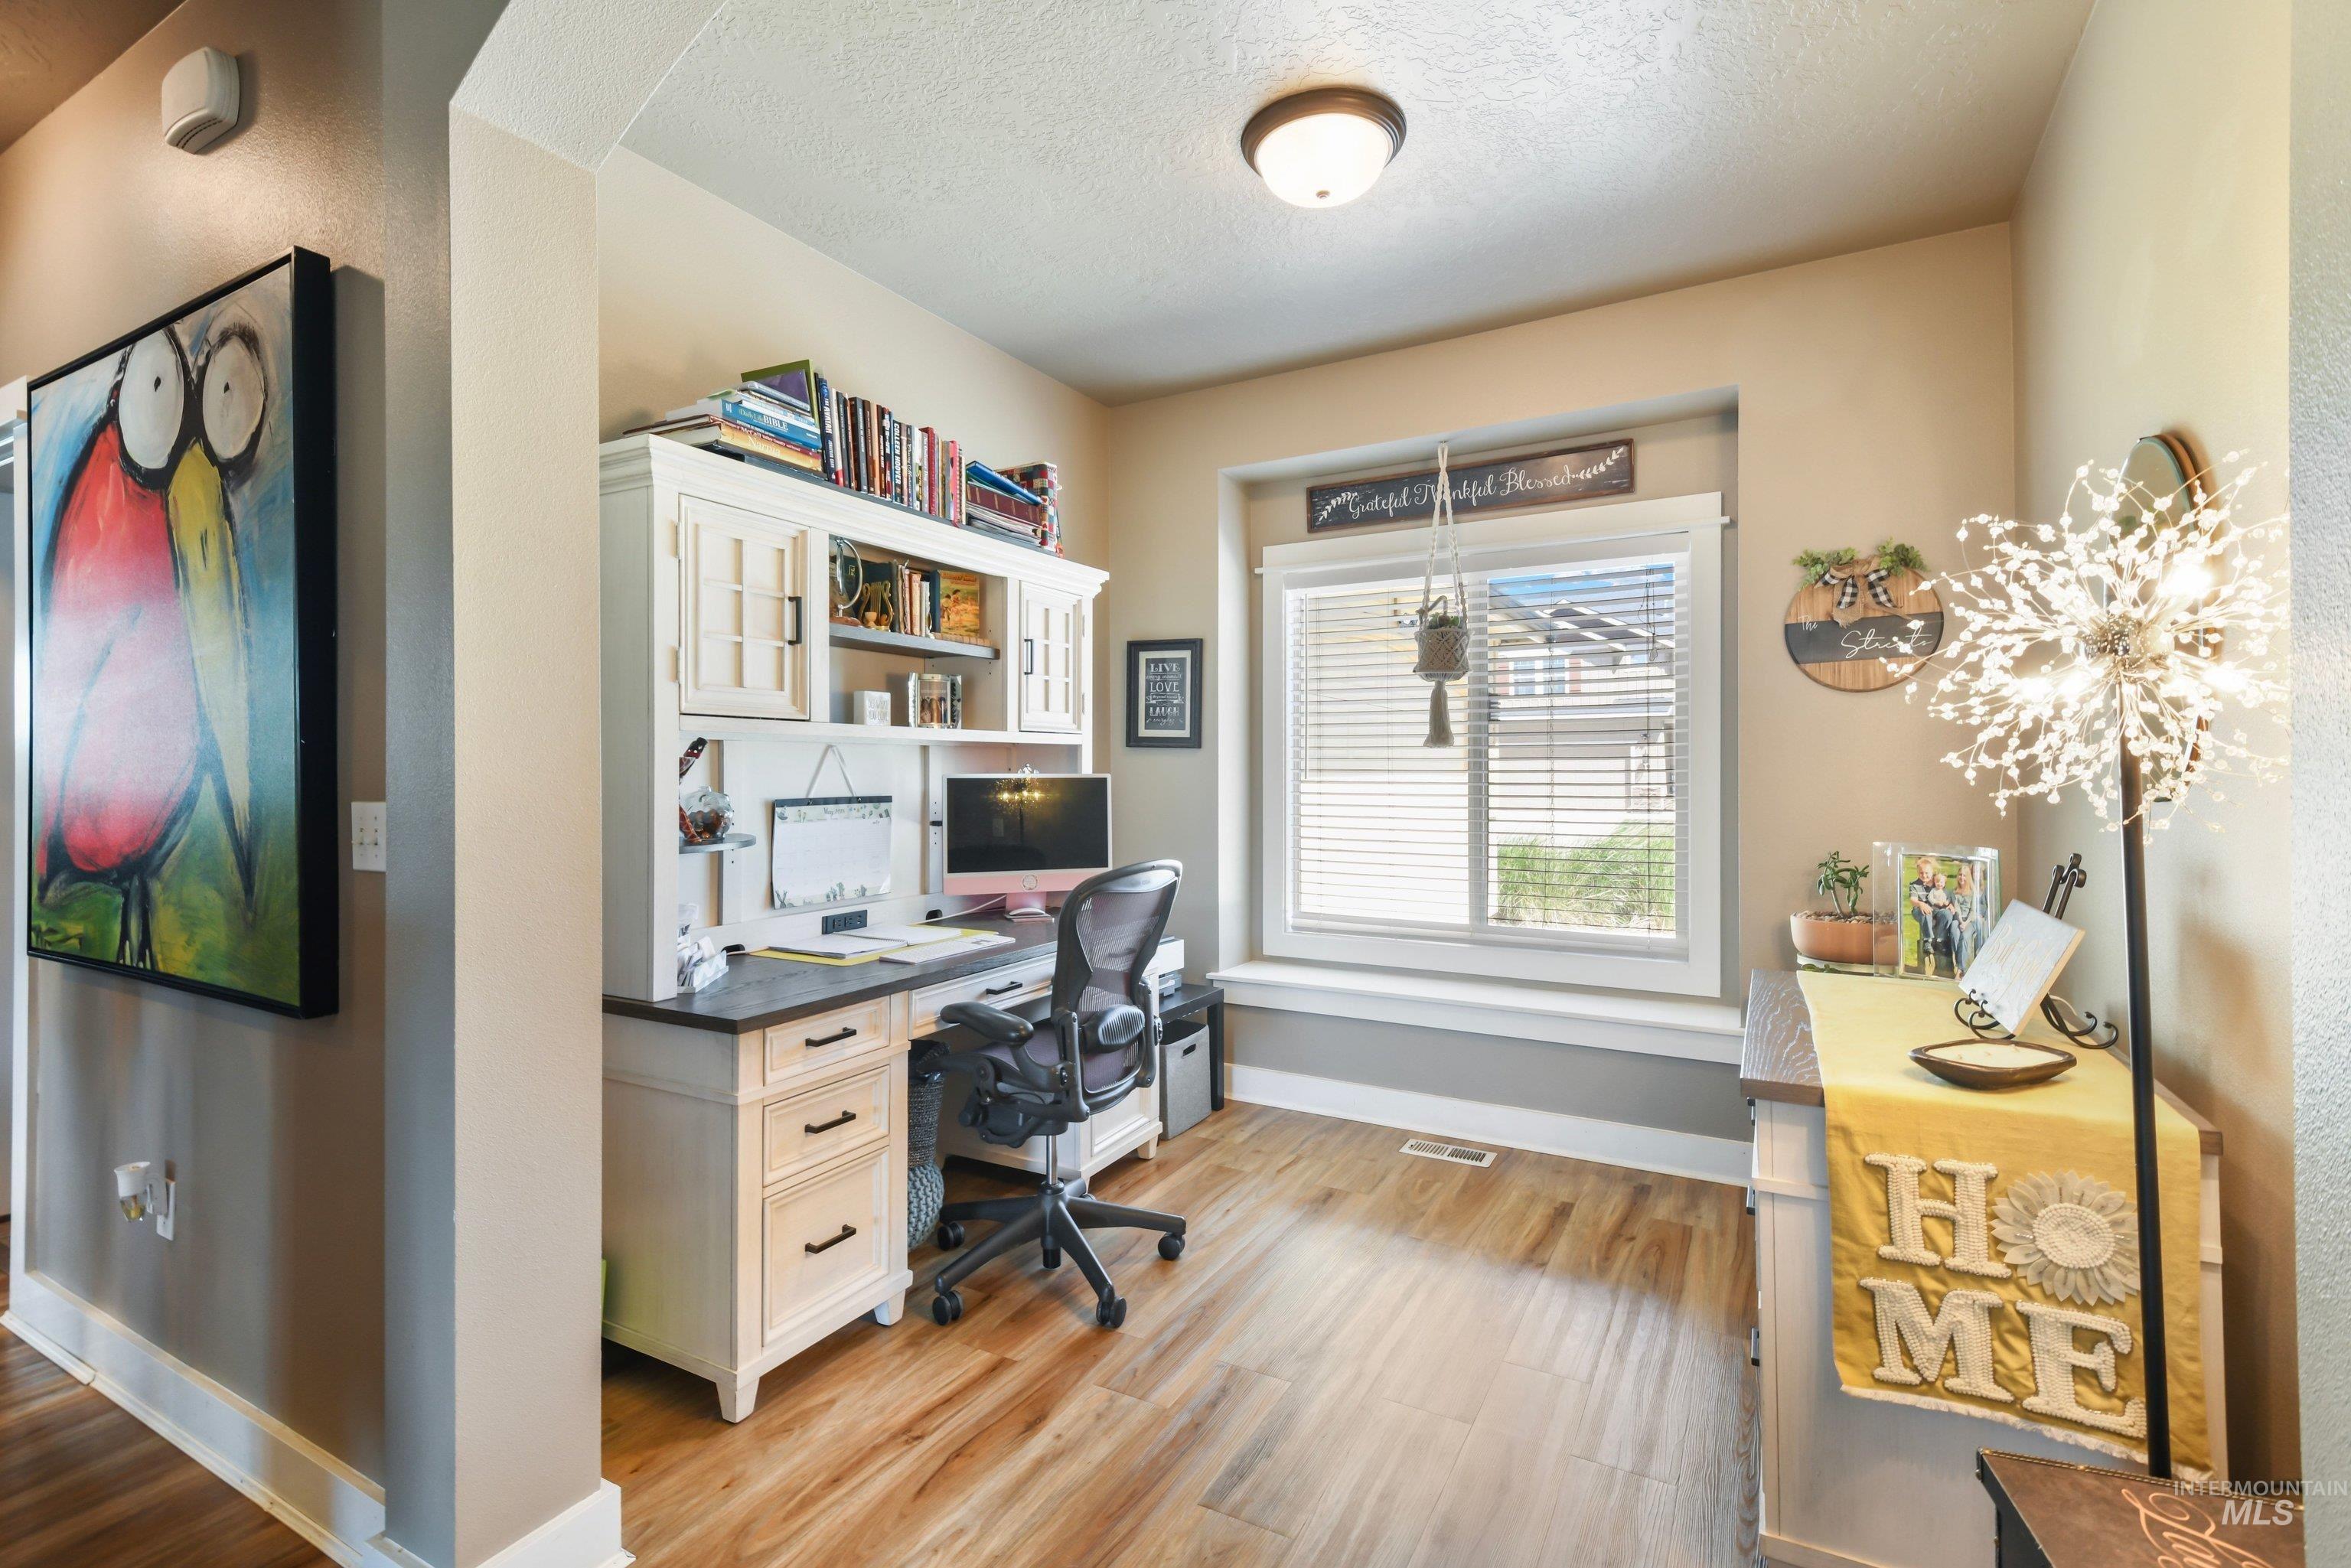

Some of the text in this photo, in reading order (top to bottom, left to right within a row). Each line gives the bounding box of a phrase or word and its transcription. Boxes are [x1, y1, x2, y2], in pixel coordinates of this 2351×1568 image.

[763, 414, 789, 430] BIBLE
[747, 435, 781, 457] Narnia
[1349, 486, 1412, 520] Grateful
[1499, 465, 1572, 496] Blessed
[1798, 614, 1818, 631] The
[1149, 663, 1181, 673] LIVE
[1149, 682, 1180, 693] LOVE
[1149, 706, 1179, 716] LAUGH
[1858, 1276, 2147, 1439] ME
